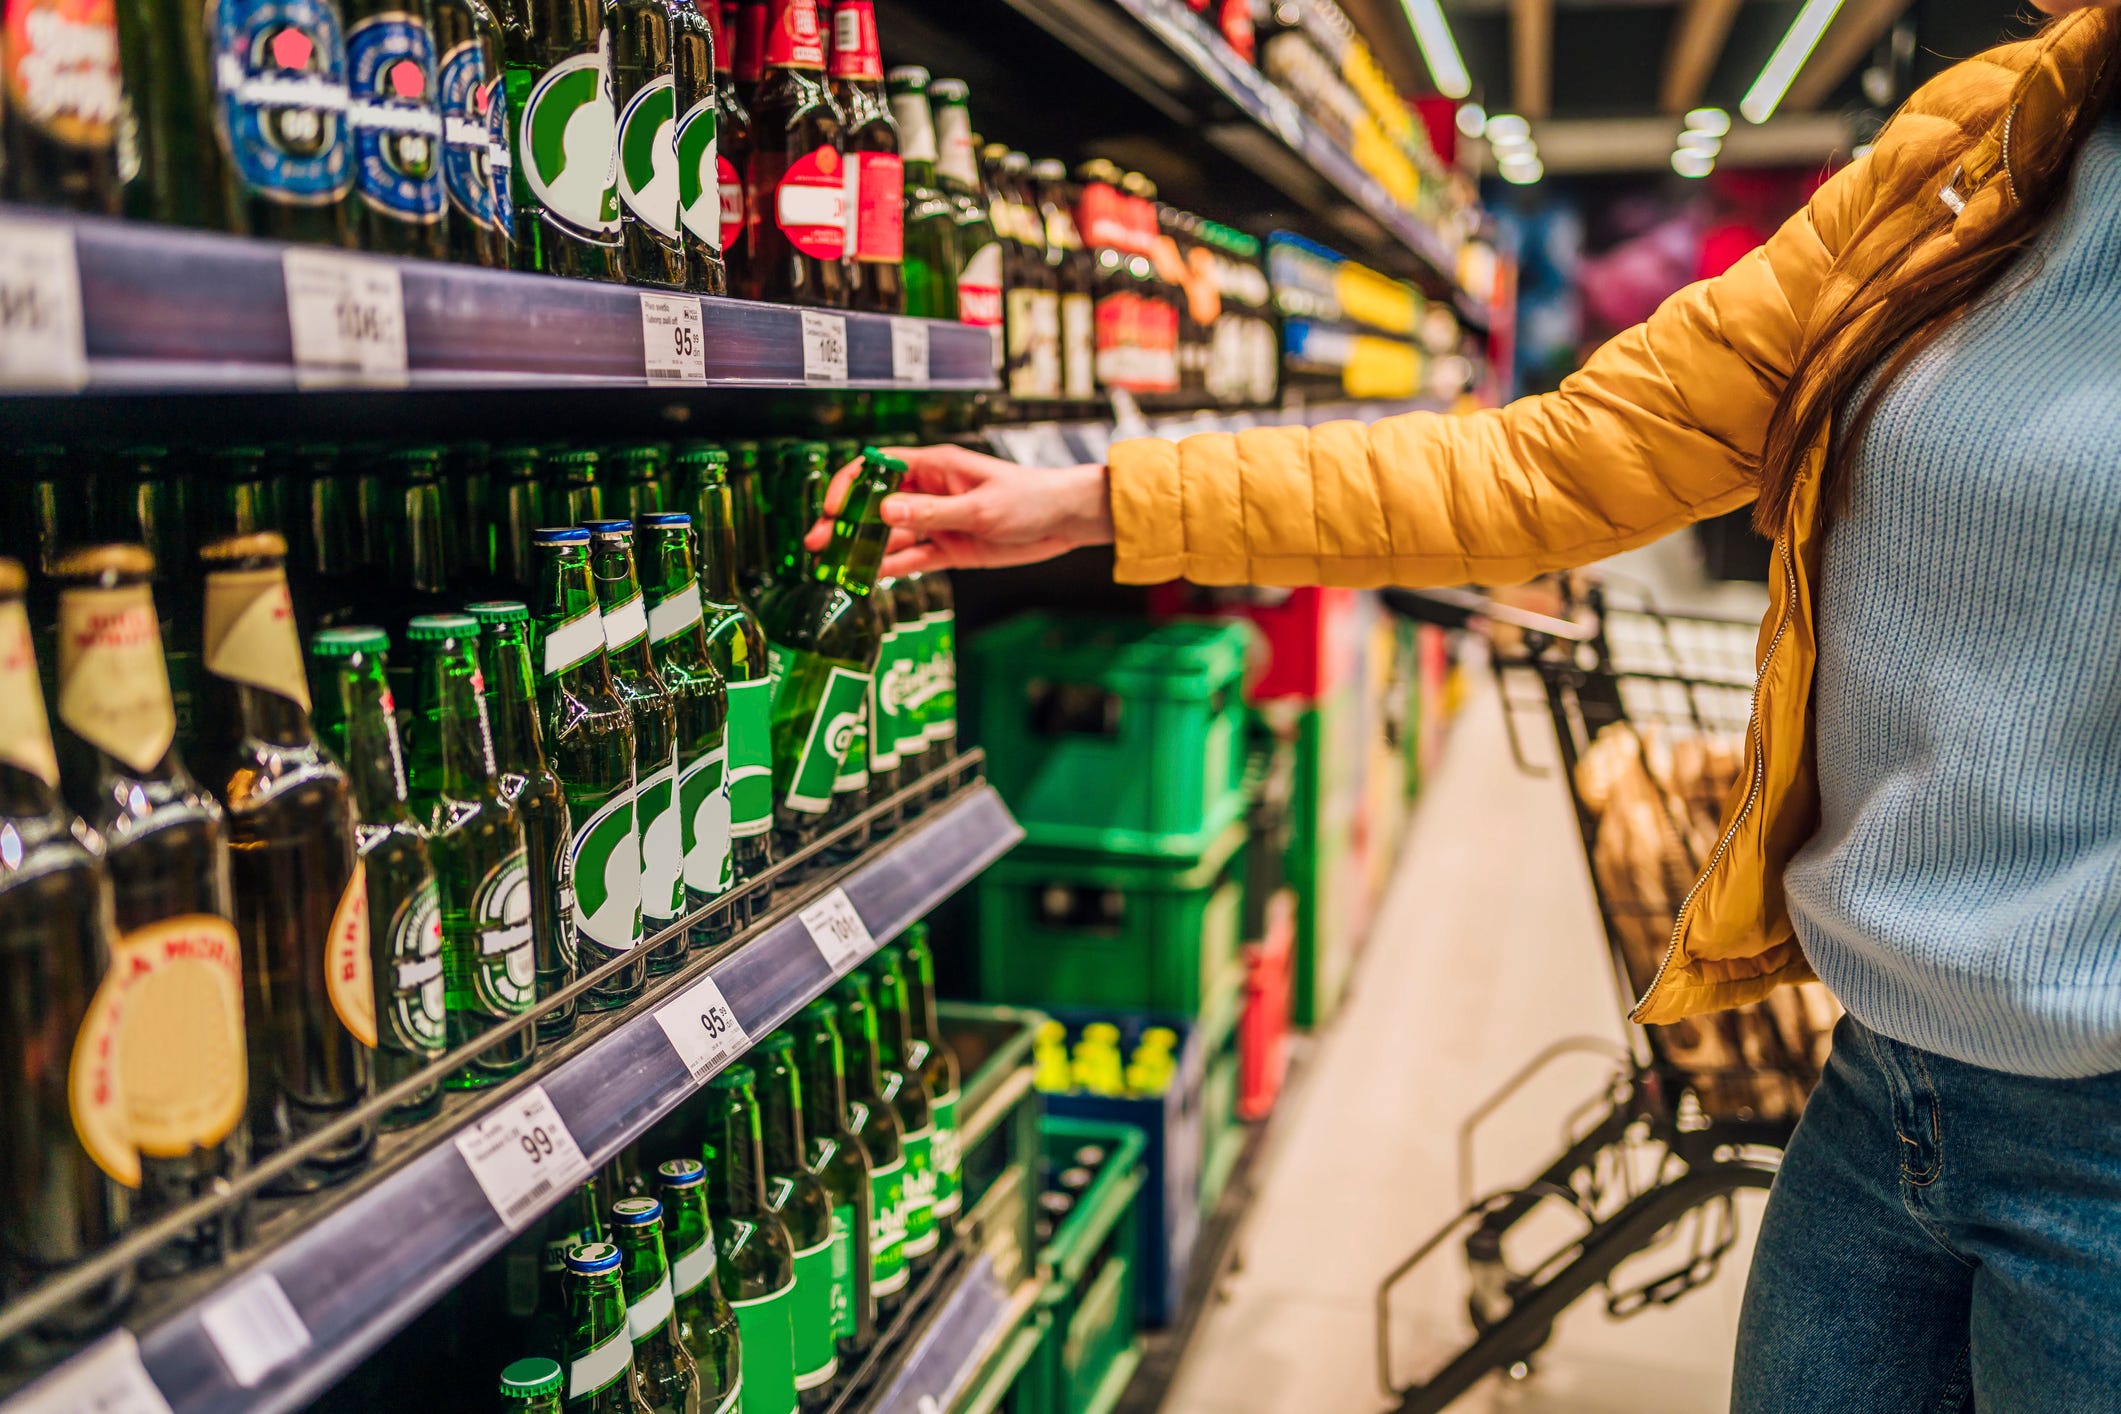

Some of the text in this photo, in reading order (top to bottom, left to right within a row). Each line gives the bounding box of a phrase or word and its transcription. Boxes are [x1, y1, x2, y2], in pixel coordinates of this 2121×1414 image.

[674, 326, 693, 356] 95
[701, 1006, 726, 1039] 95
[521, 1126, 553, 1164] 99
